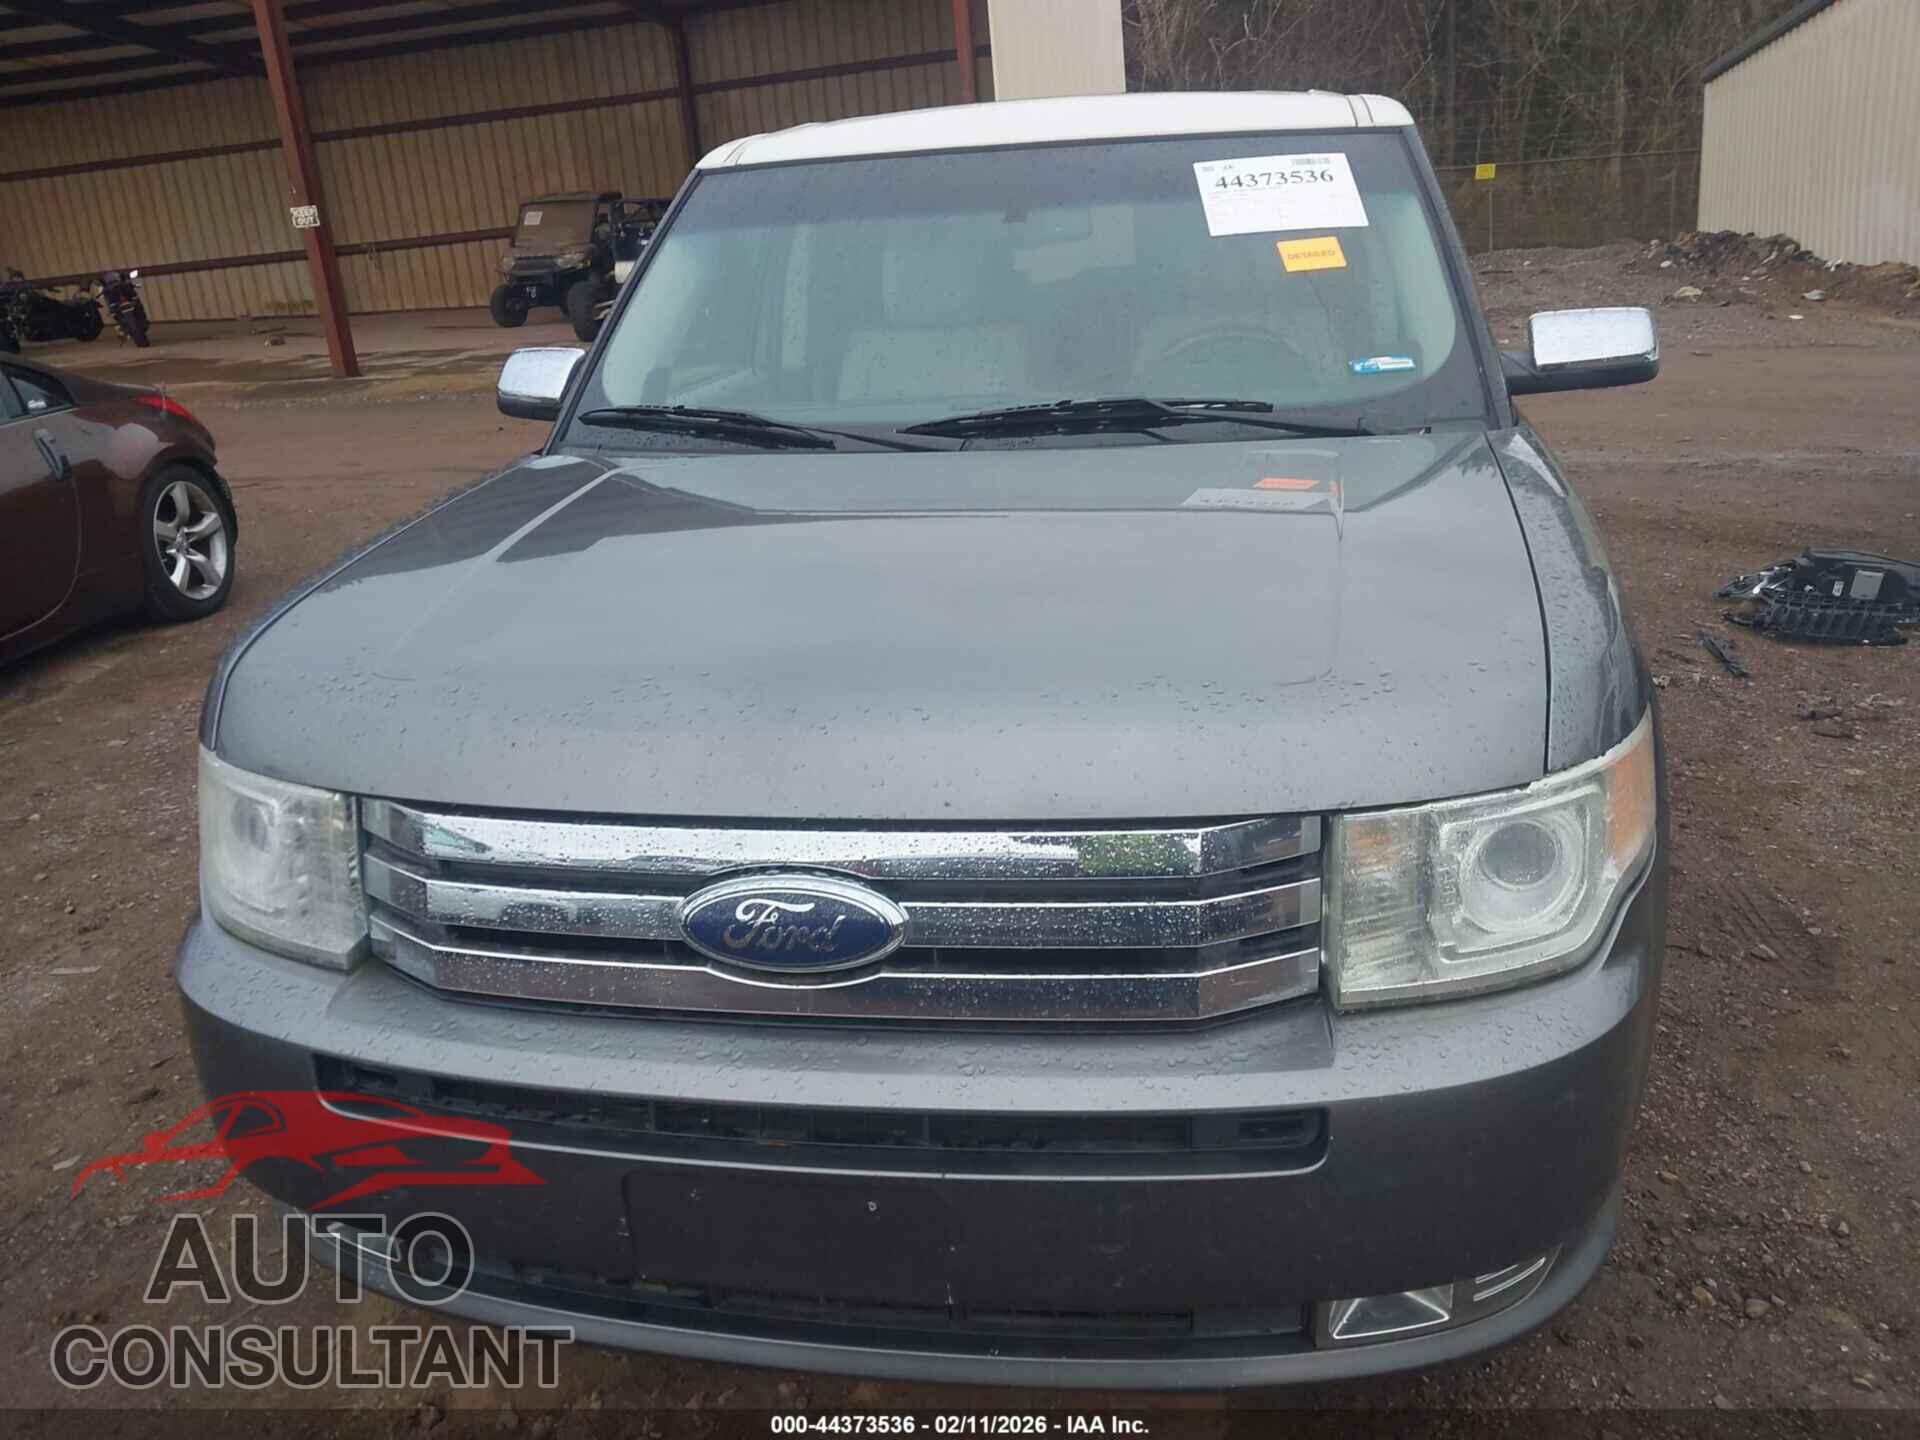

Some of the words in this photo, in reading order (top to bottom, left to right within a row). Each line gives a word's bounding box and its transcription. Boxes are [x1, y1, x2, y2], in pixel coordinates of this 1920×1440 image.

[1215, 169, 1335, 189] 44373536
[293, 208, 317, 217] KEEP
[297, 216, 316, 226] OUT
[723, 898, 846, 951] Ford
